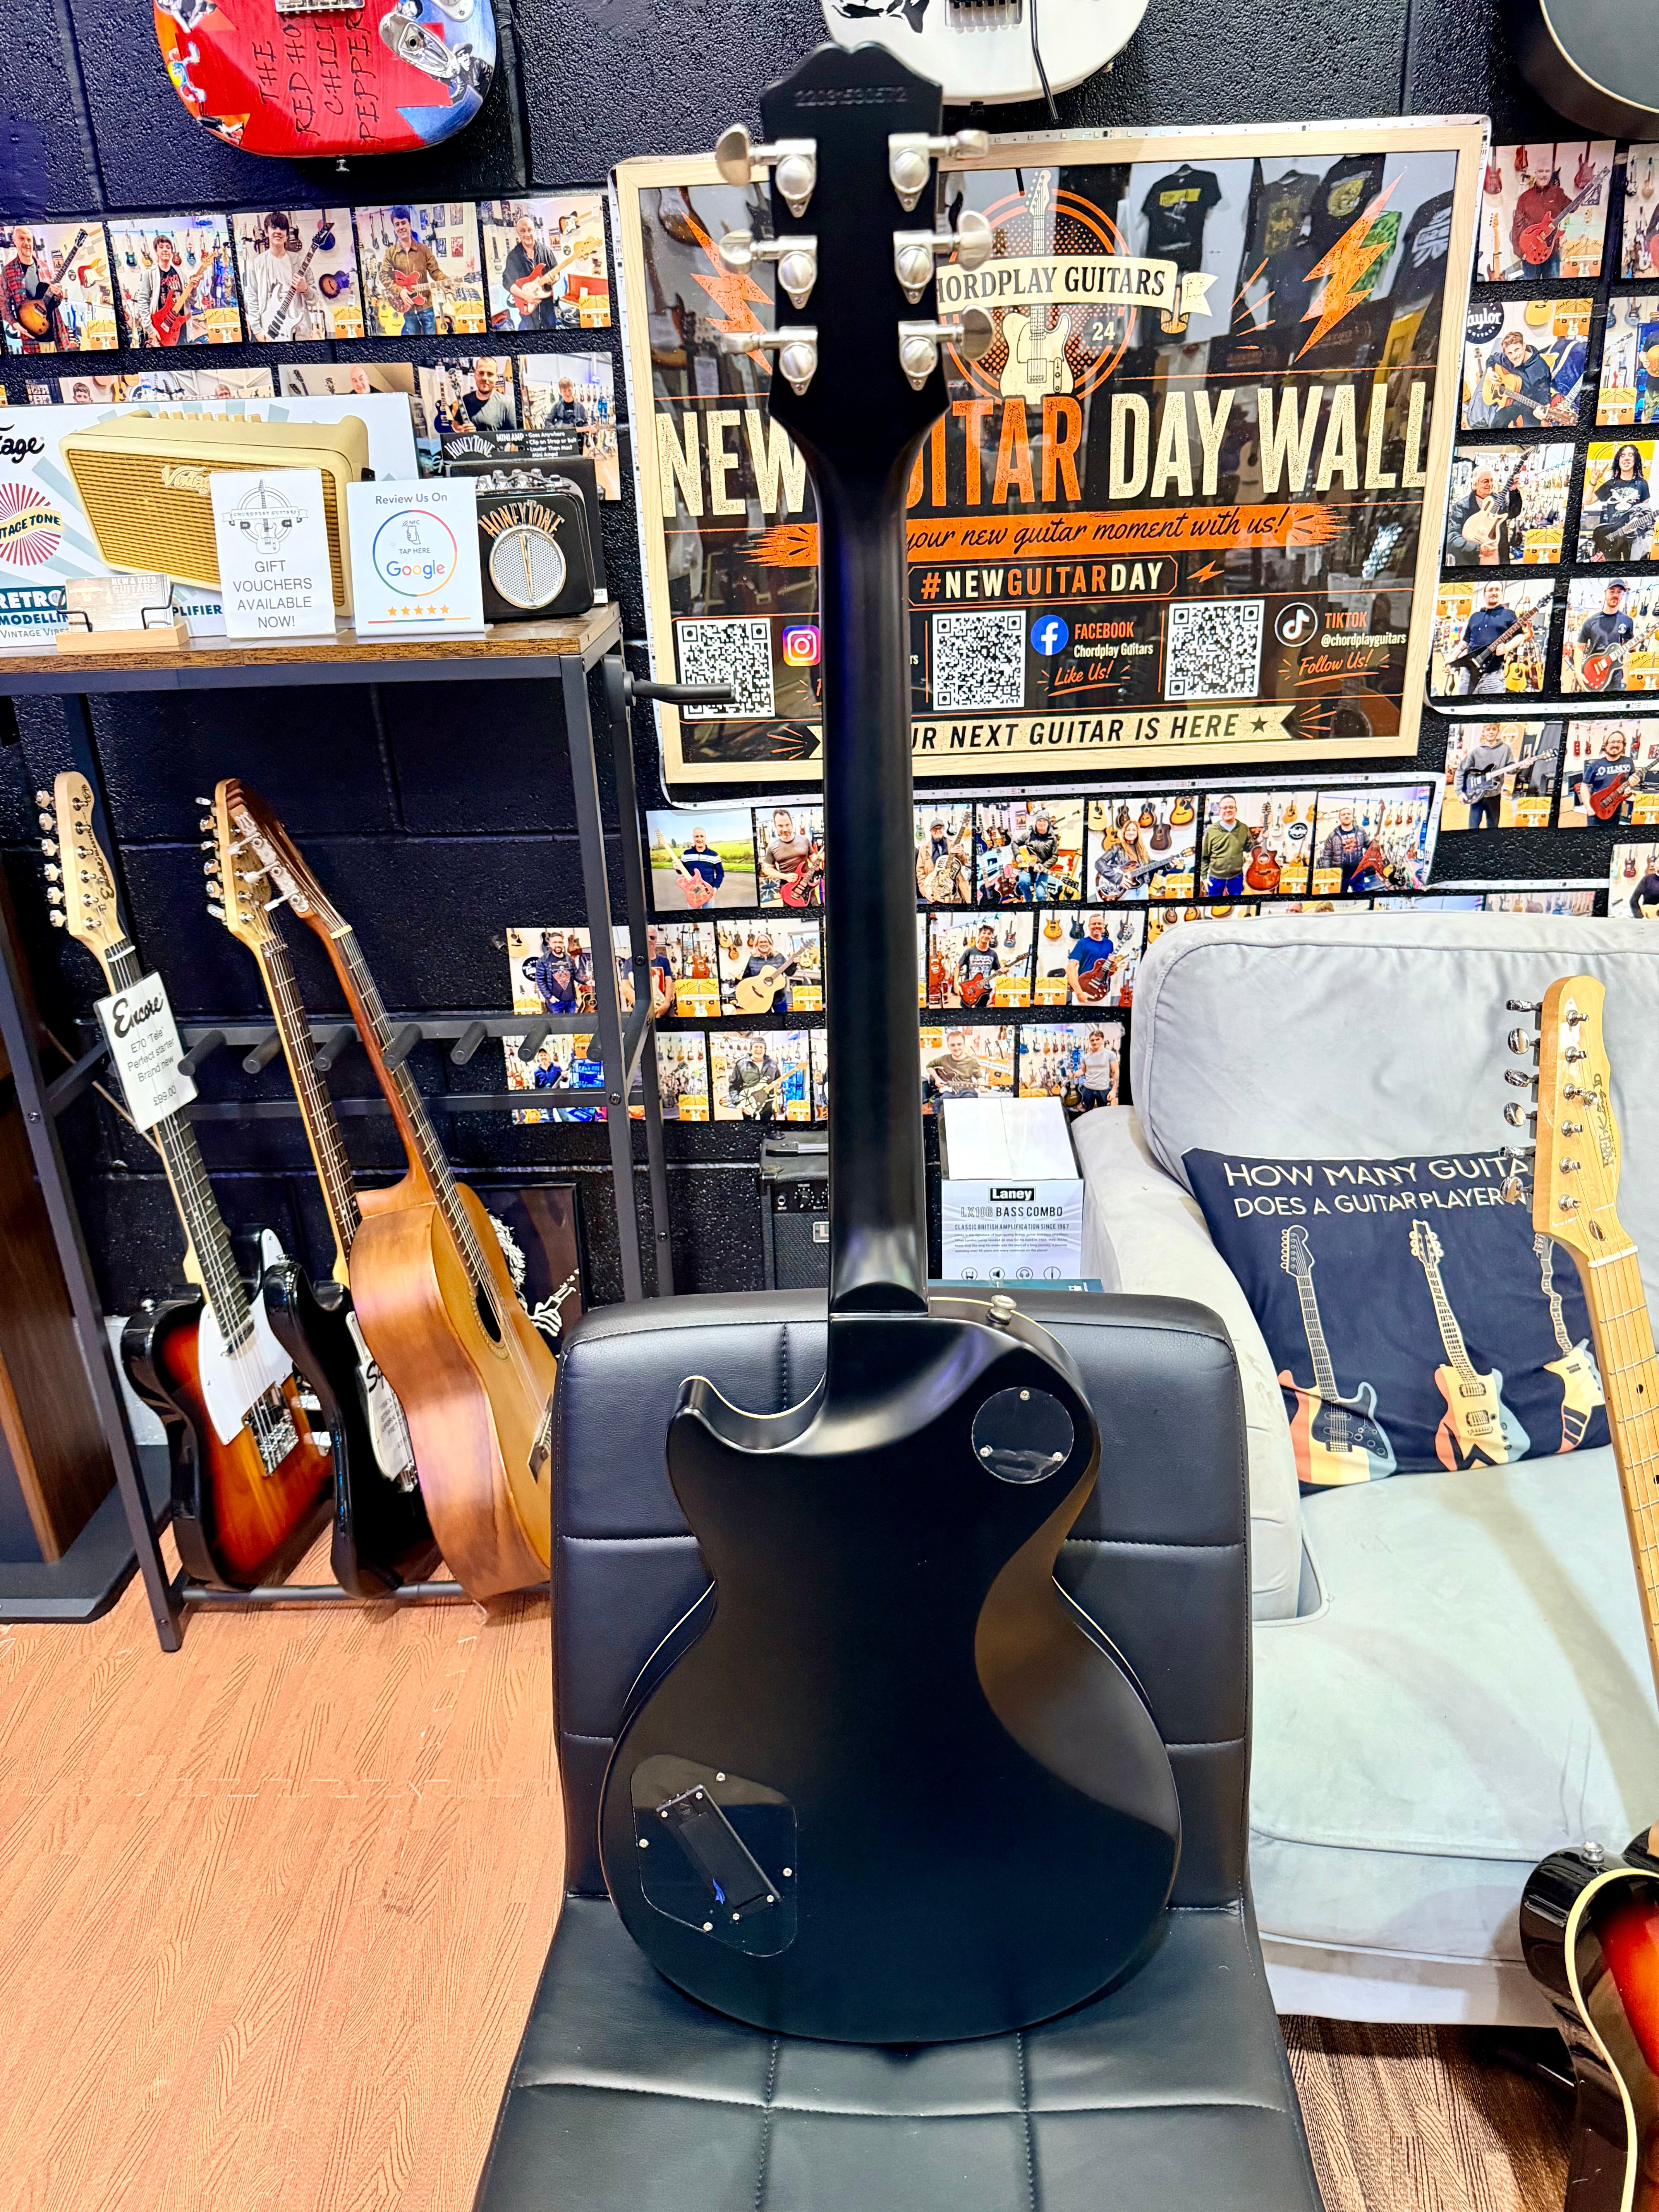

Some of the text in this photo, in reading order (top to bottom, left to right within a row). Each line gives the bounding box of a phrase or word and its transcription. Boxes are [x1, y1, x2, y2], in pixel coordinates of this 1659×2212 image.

[252, 41, 279, 104] THE
[282, 12, 321, 136] RED HO
[314, 22, 343, 115] CHILI
[346, 9, 384, 144] PEPPER
[936, 266, 1166, 303] HORDPLAY GUITARS
[1467, 308, 1502, 330] aylor
[1092, 321, 1115, 342] 24
[496, 433, 511, 442] MINI
[511, 433, 524, 441] AMP
[656, 381, 1427, 517] NEW ITAR DAY WALL
[161, 465, 210, 496] Vintag
[375, 492, 447, 504] Review Us On
[0, 514, 61, 539] TAGE TONE
[960, 527, 1008, 546] new
[1013, 518, 1087, 555] guitar
[1092, 517, 1184, 541] moment
[1181, 507, 1240, 537] with
[1246, 507, 1287, 534] us!
[254, 560, 286, 572] GIFT
[386, 559, 445, 579] Google
[112, 577, 129, 585] NEW
[112, 583, 157, 594] GUITARS
[233, 577, 313, 592] VOUCHERS
[921, 562, 1163, 599] #NEWGUITARDAY
[237, 596, 312, 611] AVAILABLE
[0, 613, 69, 625] MODELLIN
[258, 615, 295, 628] NOW!
[1324, 611, 1367, 629] TIKTOK
[1075, 622, 1134, 640] FACEBOOK
[1321, 632, 1407, 648] @chordplayguitars
[1074, 642, 1154, 659] Chordplay Guitars
[1054, 659, 1114, 685] Like Us!
[1298, 648, 1374, 676] Follow Us!
[950, 723, 1019, 749] NEXT
[1029, 720, 1123, 746] GUITAR
[1134, 716, 1159, 741] IS
[1170, 713, 1239, 739] HERE
[112, 997, 164, 1038] Encore
[127, 1038, 174, 1072] Perfect starter
[131, 1038, 147, 1054] E70
[138, 1055, 174, 1082] Brand new
[153, 1085, 177, 1106] £99.00
[1224, 1157, 1528, 1187] HOW MANY GUITA
[992, 1188, 1032, 1200] Laney
[1234, 1196, 1307, 1218] DOES
[1313, 1197, 1331, 1215] A
[1334, 1190, 1417, 1213] GUITAR
[1418, 1187, 1505, 1209] PLAYER
[961, 1206, 1063, 1218] LX10B BASS COMBO
